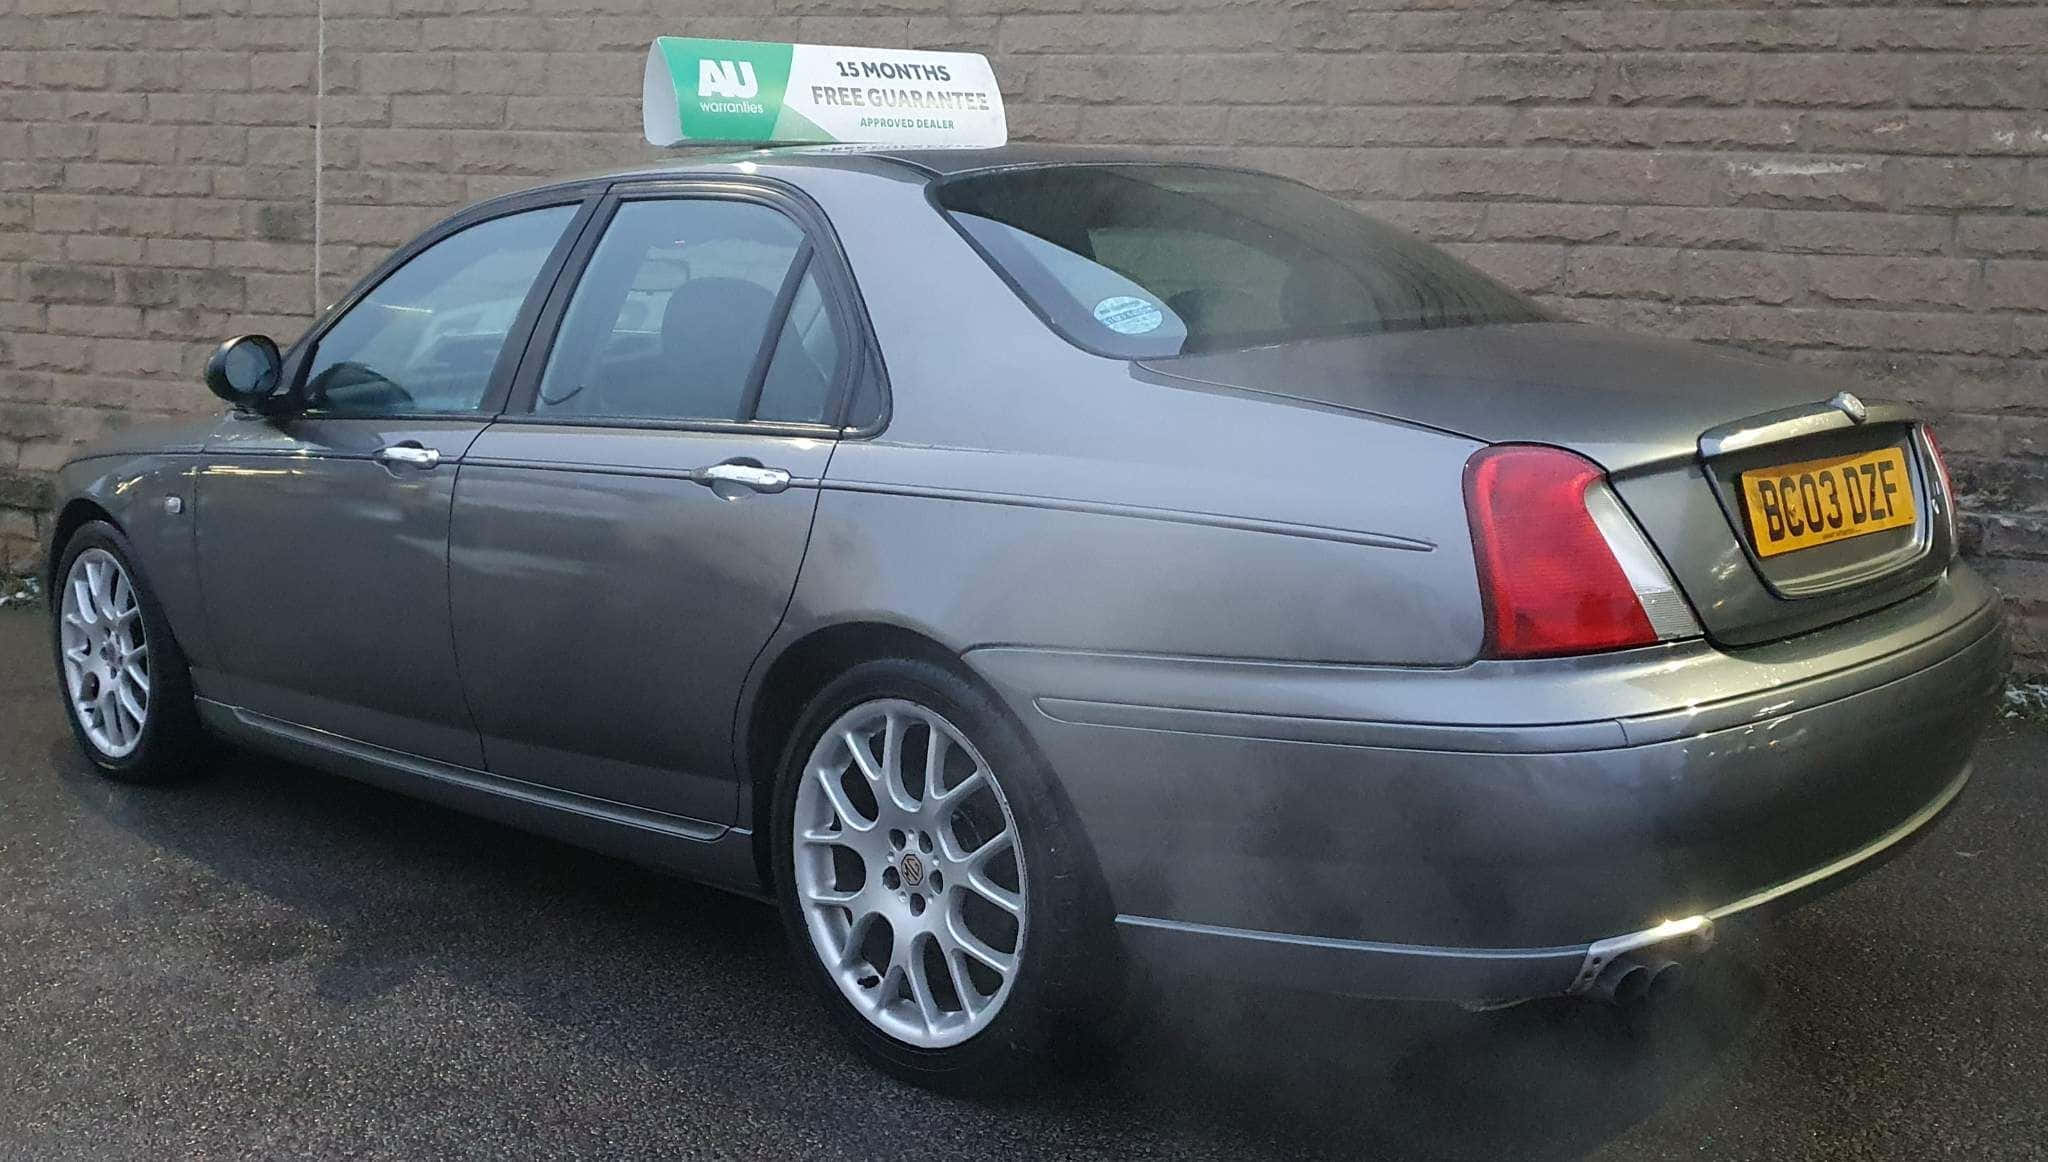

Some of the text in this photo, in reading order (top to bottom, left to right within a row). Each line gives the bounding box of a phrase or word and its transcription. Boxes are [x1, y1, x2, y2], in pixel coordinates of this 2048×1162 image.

[697, 59, 759, 99] AU
[836, 61, 951, 81] 15 MONTHS
[699, 101, 764, 113] warranties
[811, 86, 990, 110] FREE GUARANTEE
[860, 118, 954, 129] APPROVED DEALER
[1758, 460, 1897, 542] BC03 DZF
